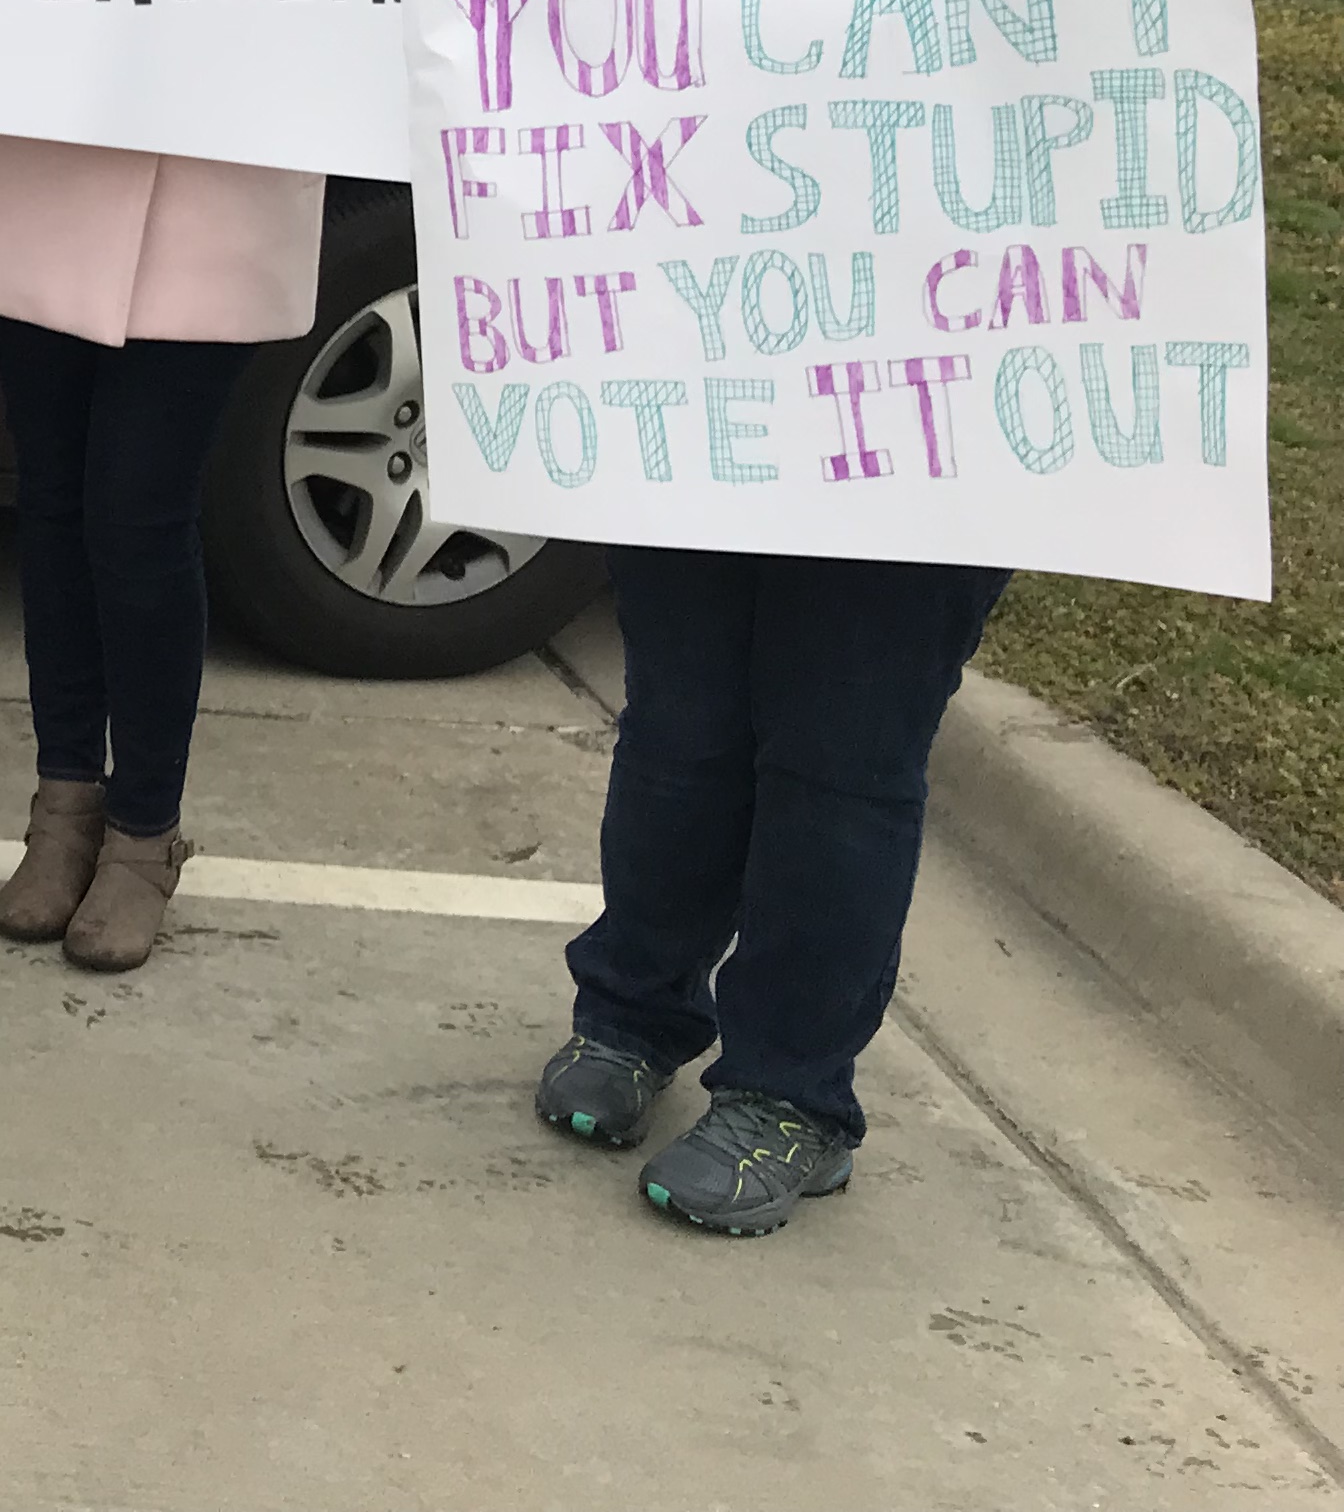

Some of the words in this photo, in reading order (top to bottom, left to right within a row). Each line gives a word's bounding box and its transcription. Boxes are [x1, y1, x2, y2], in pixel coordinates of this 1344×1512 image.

[440, 114, 708, 240] FIX
[740, 68, 1258, 234] STUPID
[453, 271, 636, 375] BUT
[657, 249, 876, 362] YOU
[921, 244, 1148, 331] CAN
[451, 376, 779, 489] VOTE
[806, 354, 972, 483] IT
[994, 341, 1250, 475] OUT
